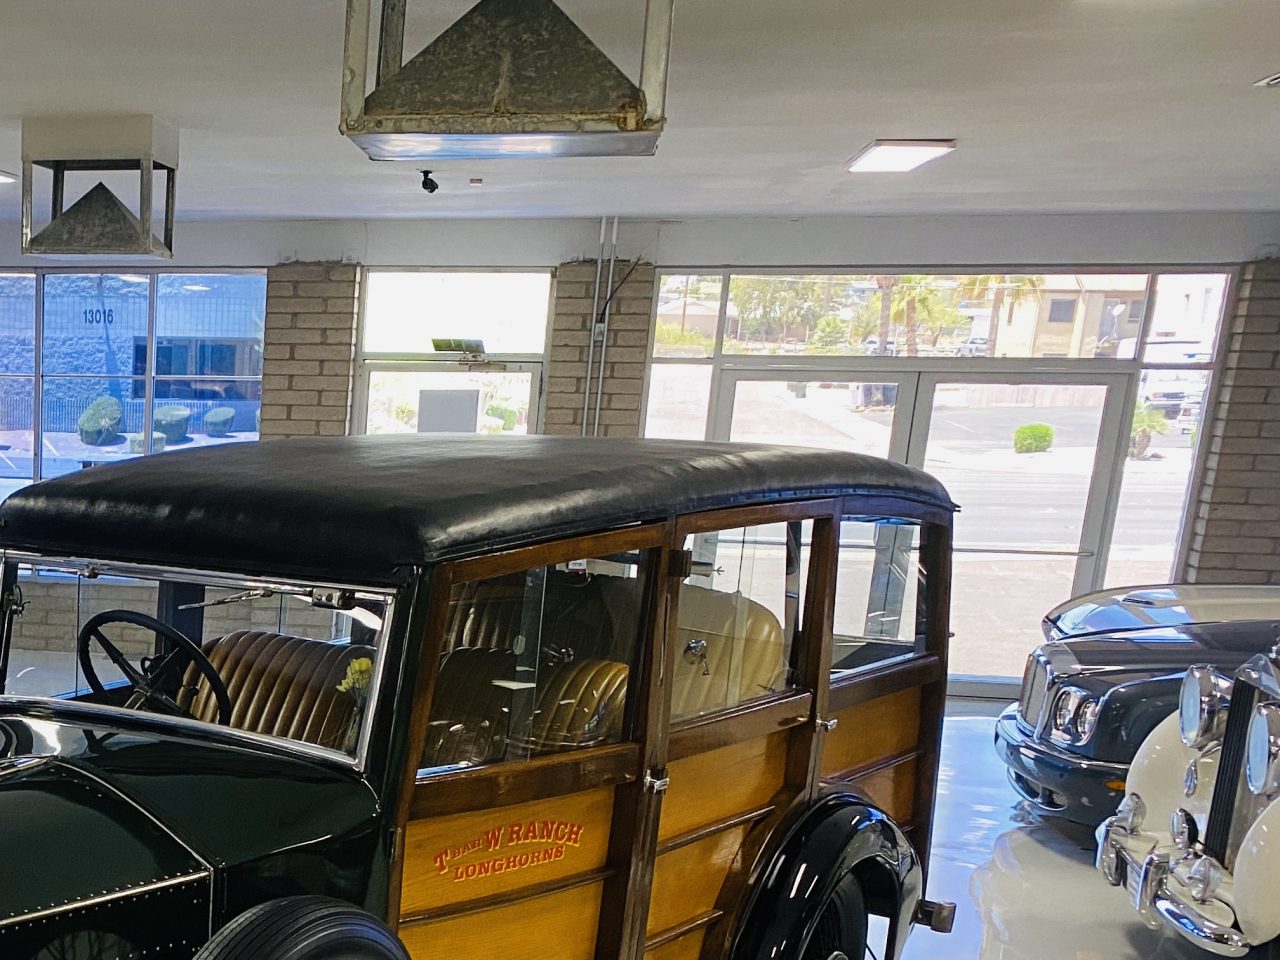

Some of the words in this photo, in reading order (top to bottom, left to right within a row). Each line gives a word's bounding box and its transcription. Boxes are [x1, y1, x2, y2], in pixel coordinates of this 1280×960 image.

[83, 308, 114, 324] 13016
[483, 826, 504, 851] W
[508, 819, 584, 847] RANCH
[452, 845, 566, 882] LONGHORNS
